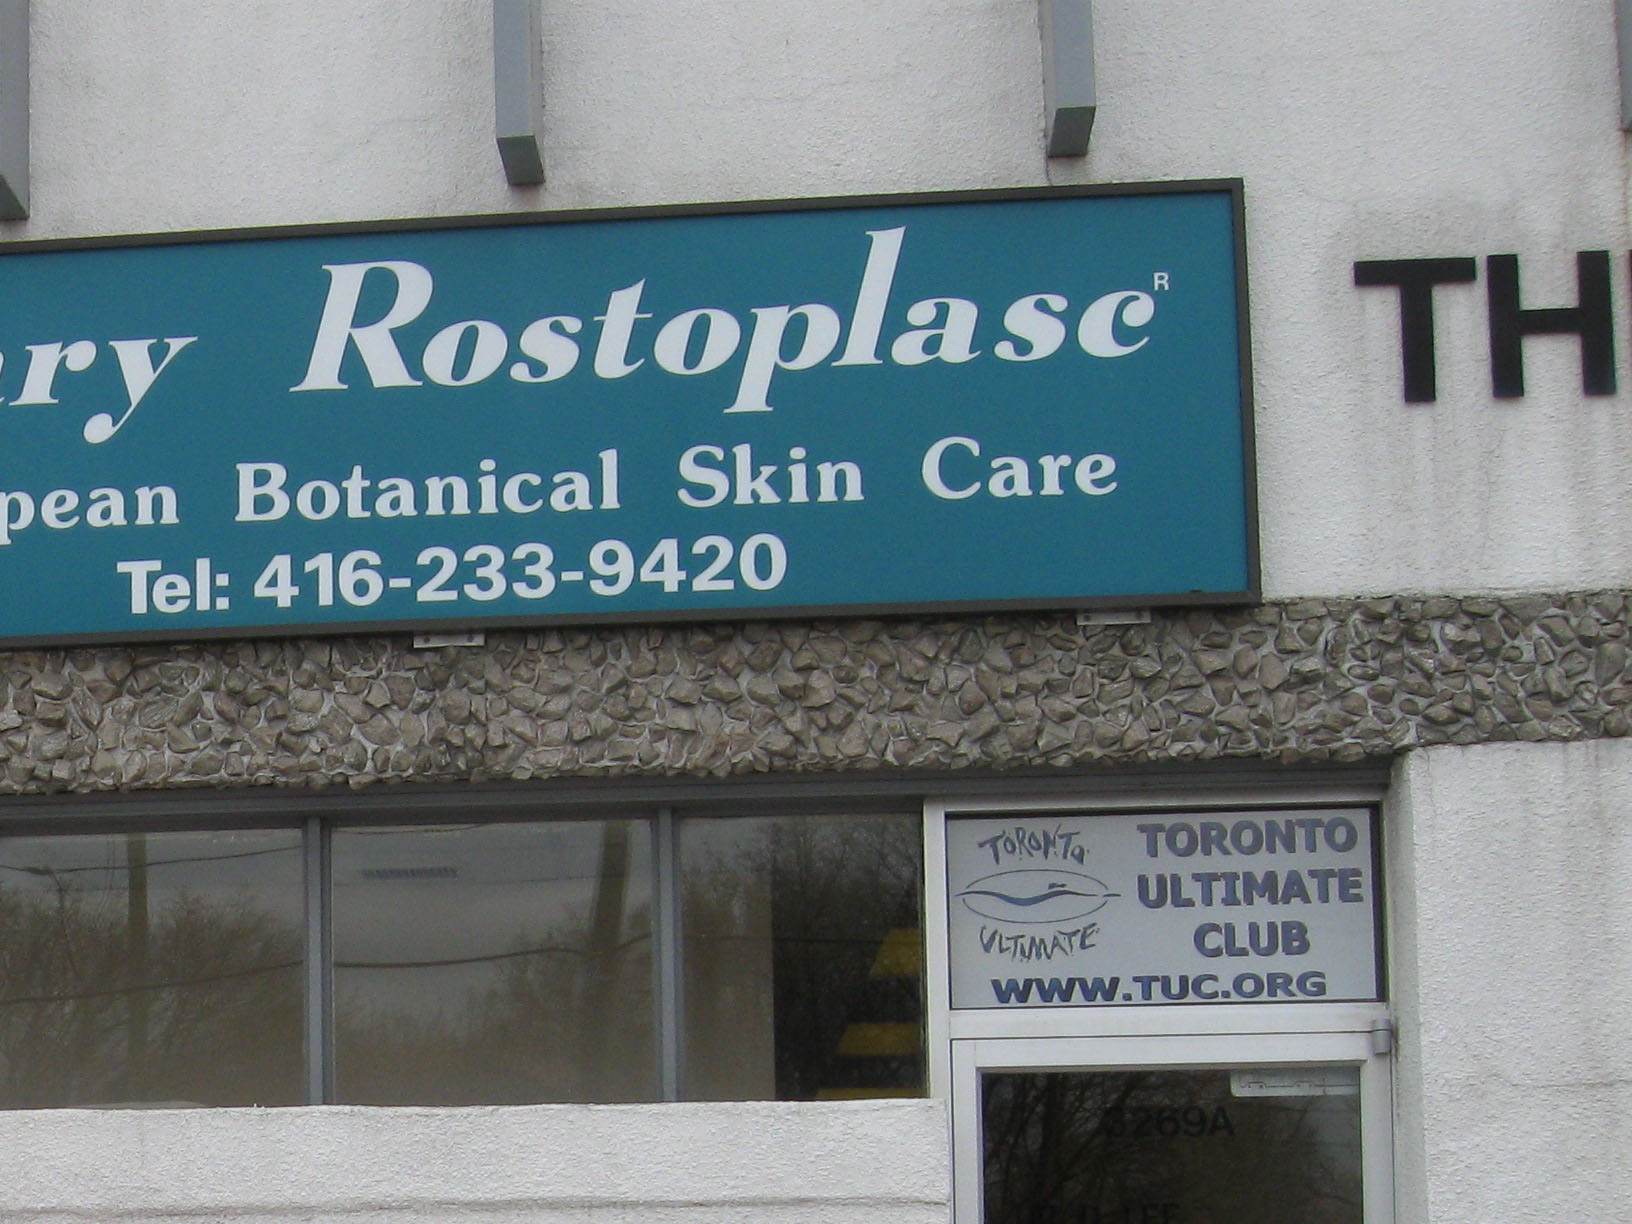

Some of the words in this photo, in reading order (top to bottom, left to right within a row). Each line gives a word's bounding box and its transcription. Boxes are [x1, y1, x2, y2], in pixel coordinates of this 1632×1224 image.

[290, 226, 1155, 414] Rostoplasc
[1353, 250, 1632, 402] TH
[235, 448, 621, 522] Botanical
[677, 443, 865, 508] Skin
[921, 436, 1119, 501] Care
[117, 557, 230, 615] Tel:
[254, 533, 788, 608] 416-233-9420
[1136, 817, 1359, 858] TORONTO
[1136, 868, 1364, 909] ULTIMATE
[979, 921, 1101, 963] ULTIMATE
[1193, 920, 1310, 958] CLUB
[990, 970, 1327, 1004] WWW.TUC.ORG
